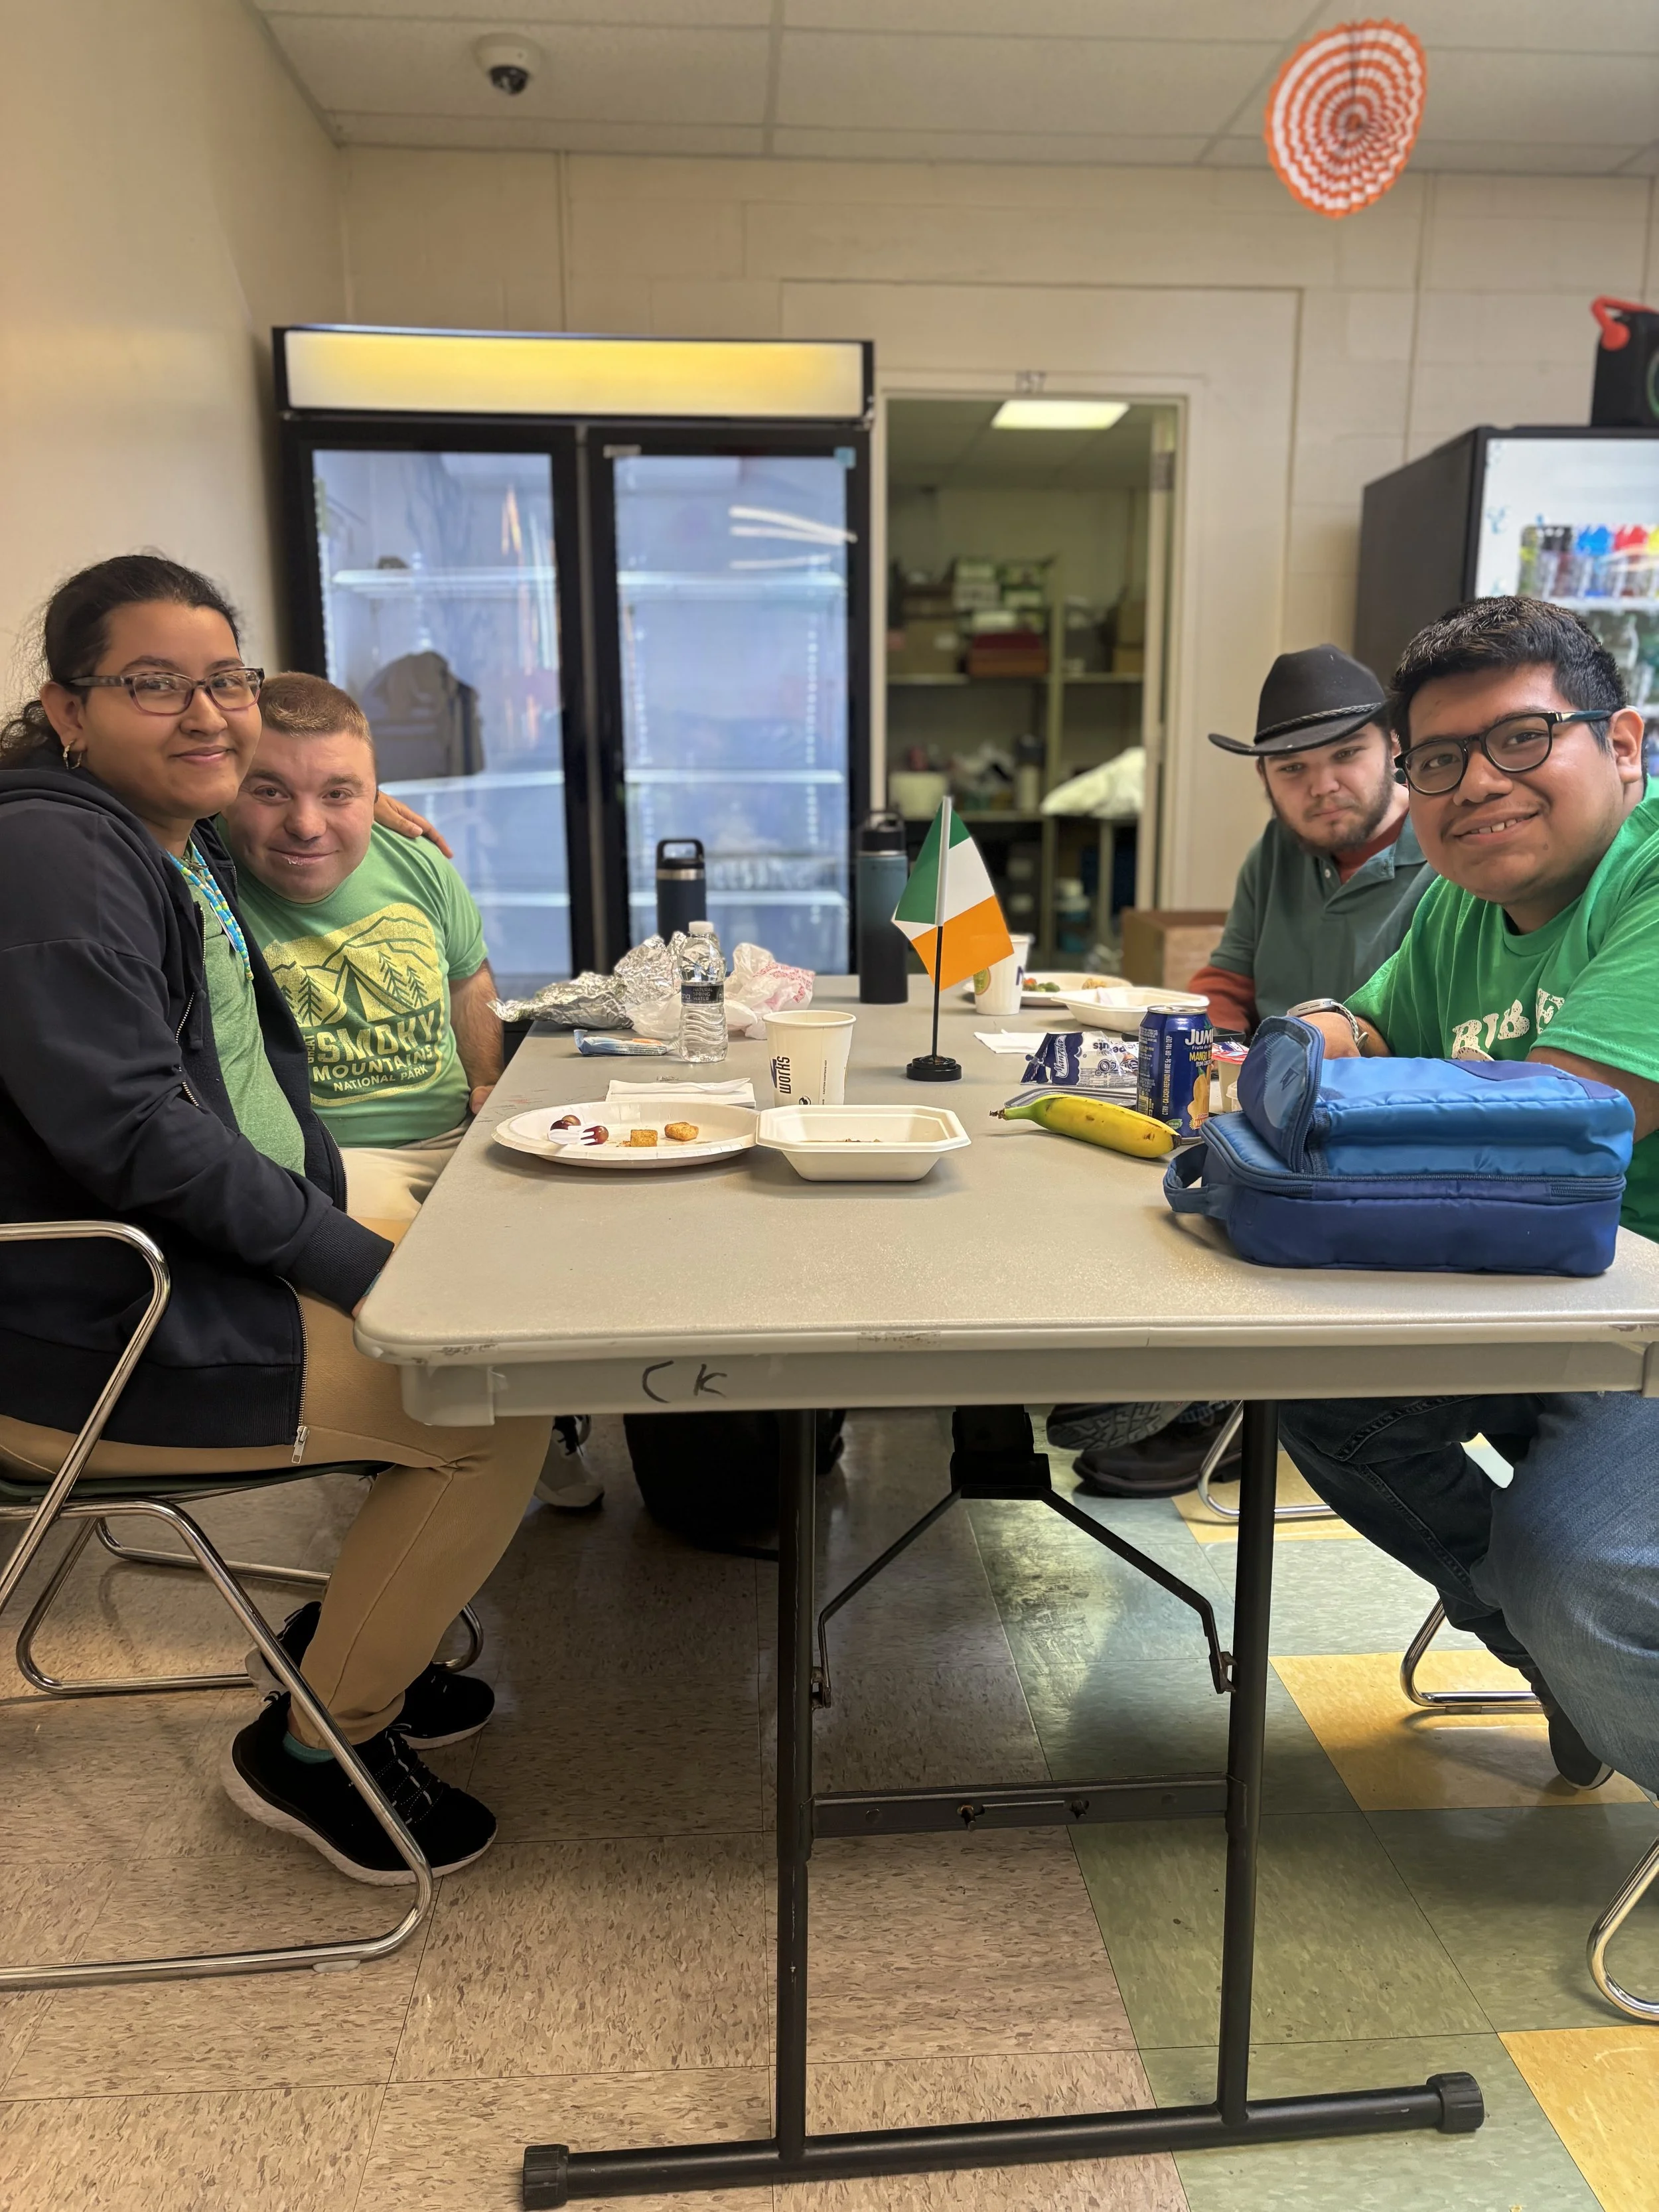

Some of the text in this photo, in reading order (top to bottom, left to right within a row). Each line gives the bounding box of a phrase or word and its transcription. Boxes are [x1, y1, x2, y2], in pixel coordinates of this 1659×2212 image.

[317, 1009, 435, 1063] SMOKY
[313, 1044, 433, 1082] MOUNTAINS
[333, 1065, 429, 1092] NATIONAL PARK
[776, 1056, 791, 1094] works
